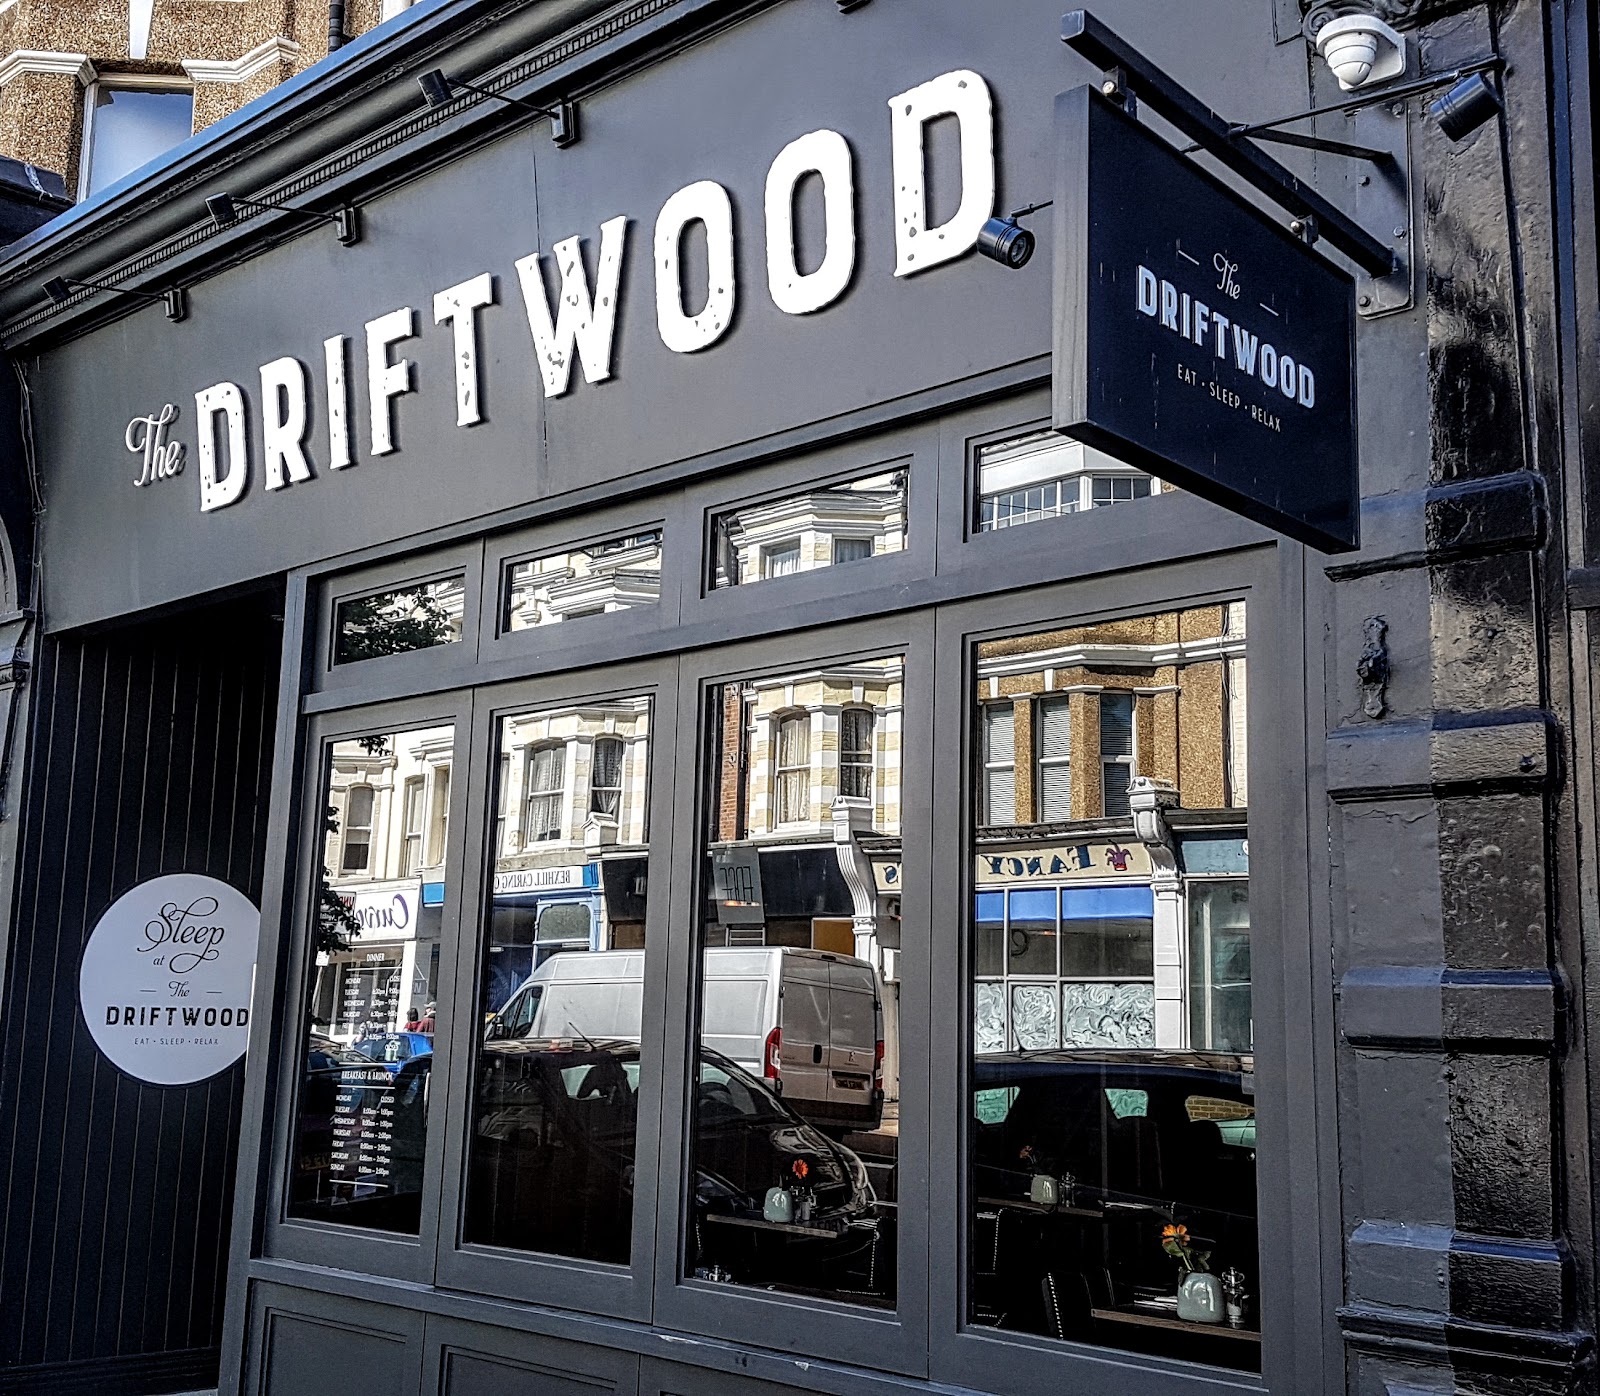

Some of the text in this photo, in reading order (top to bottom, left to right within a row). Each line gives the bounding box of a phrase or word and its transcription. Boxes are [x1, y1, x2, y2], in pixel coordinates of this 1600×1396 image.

[1213, 252, 1241, 300] The
[125, 69, 995, 513] The DRIFTWOOD
[1136, 264, 1315, 409] DRIFTWOOD
[1177, 362, 1281, 433] EAT SLEEP RELAX
[136, 896, 225, 974] Sleep
[152, 954, 165, 966] at
[367, 953, 385, 962] DINNER
[168, 980, 190, 997] The
[105, 1006, 249, 1027] DRIFTWOOD
[134, 1037, 219, 1046] EAT SLEEP RELAX
[341, 1070, 367, 1080] BREAKFAST
[336, 1094, 352, 1102] MONDAY
